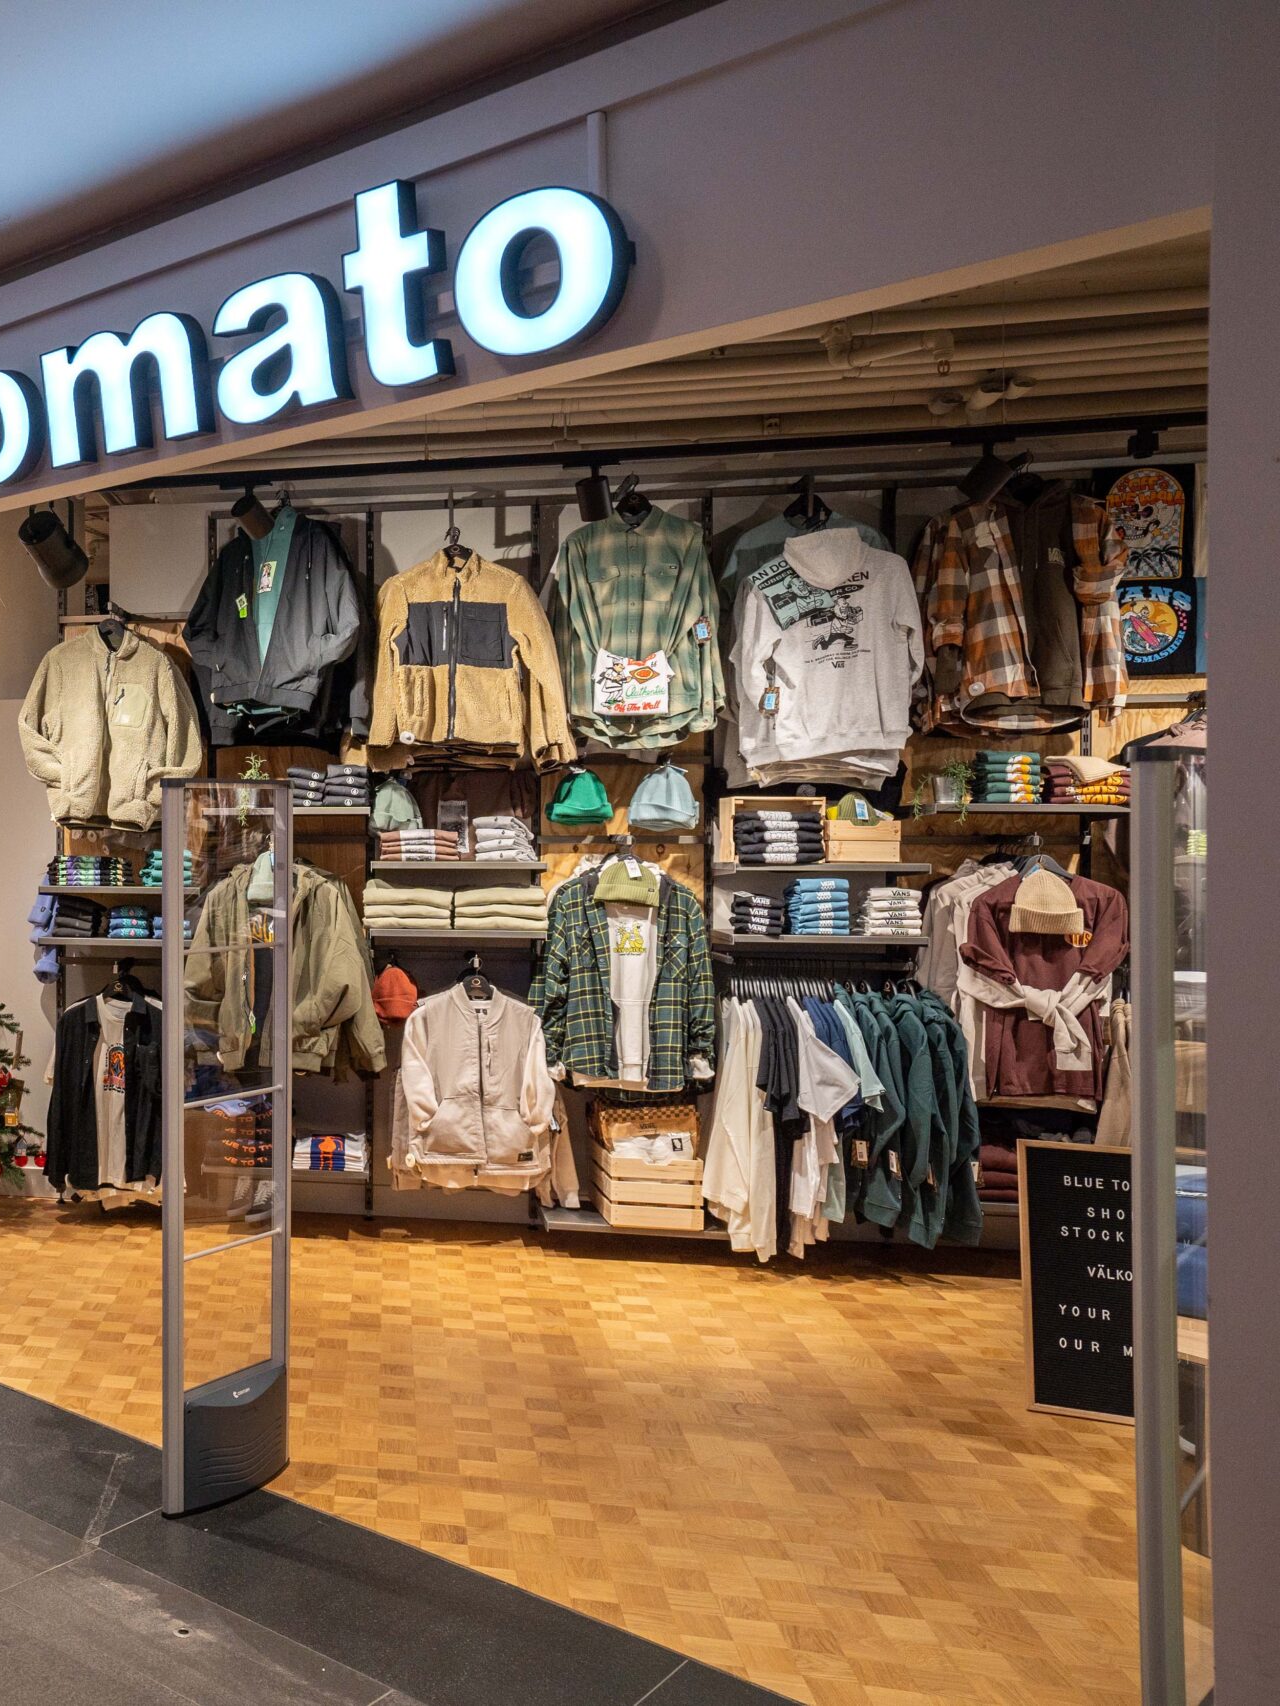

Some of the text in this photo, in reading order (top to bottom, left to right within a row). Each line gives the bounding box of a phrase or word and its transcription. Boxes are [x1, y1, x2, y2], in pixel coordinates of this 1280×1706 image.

[1063, 1175, 1130, 1191] BLUE TO
[1086, 1207, 1125, 1220] SHO
[1060, 1225, 1125, 1242] STOCK
[1087, 1264, 1133, 1282] VÄLKO
[1058, 1304, 1111, 1321] YOUR
[1058, 1337, 1133, 1358] OUR M
